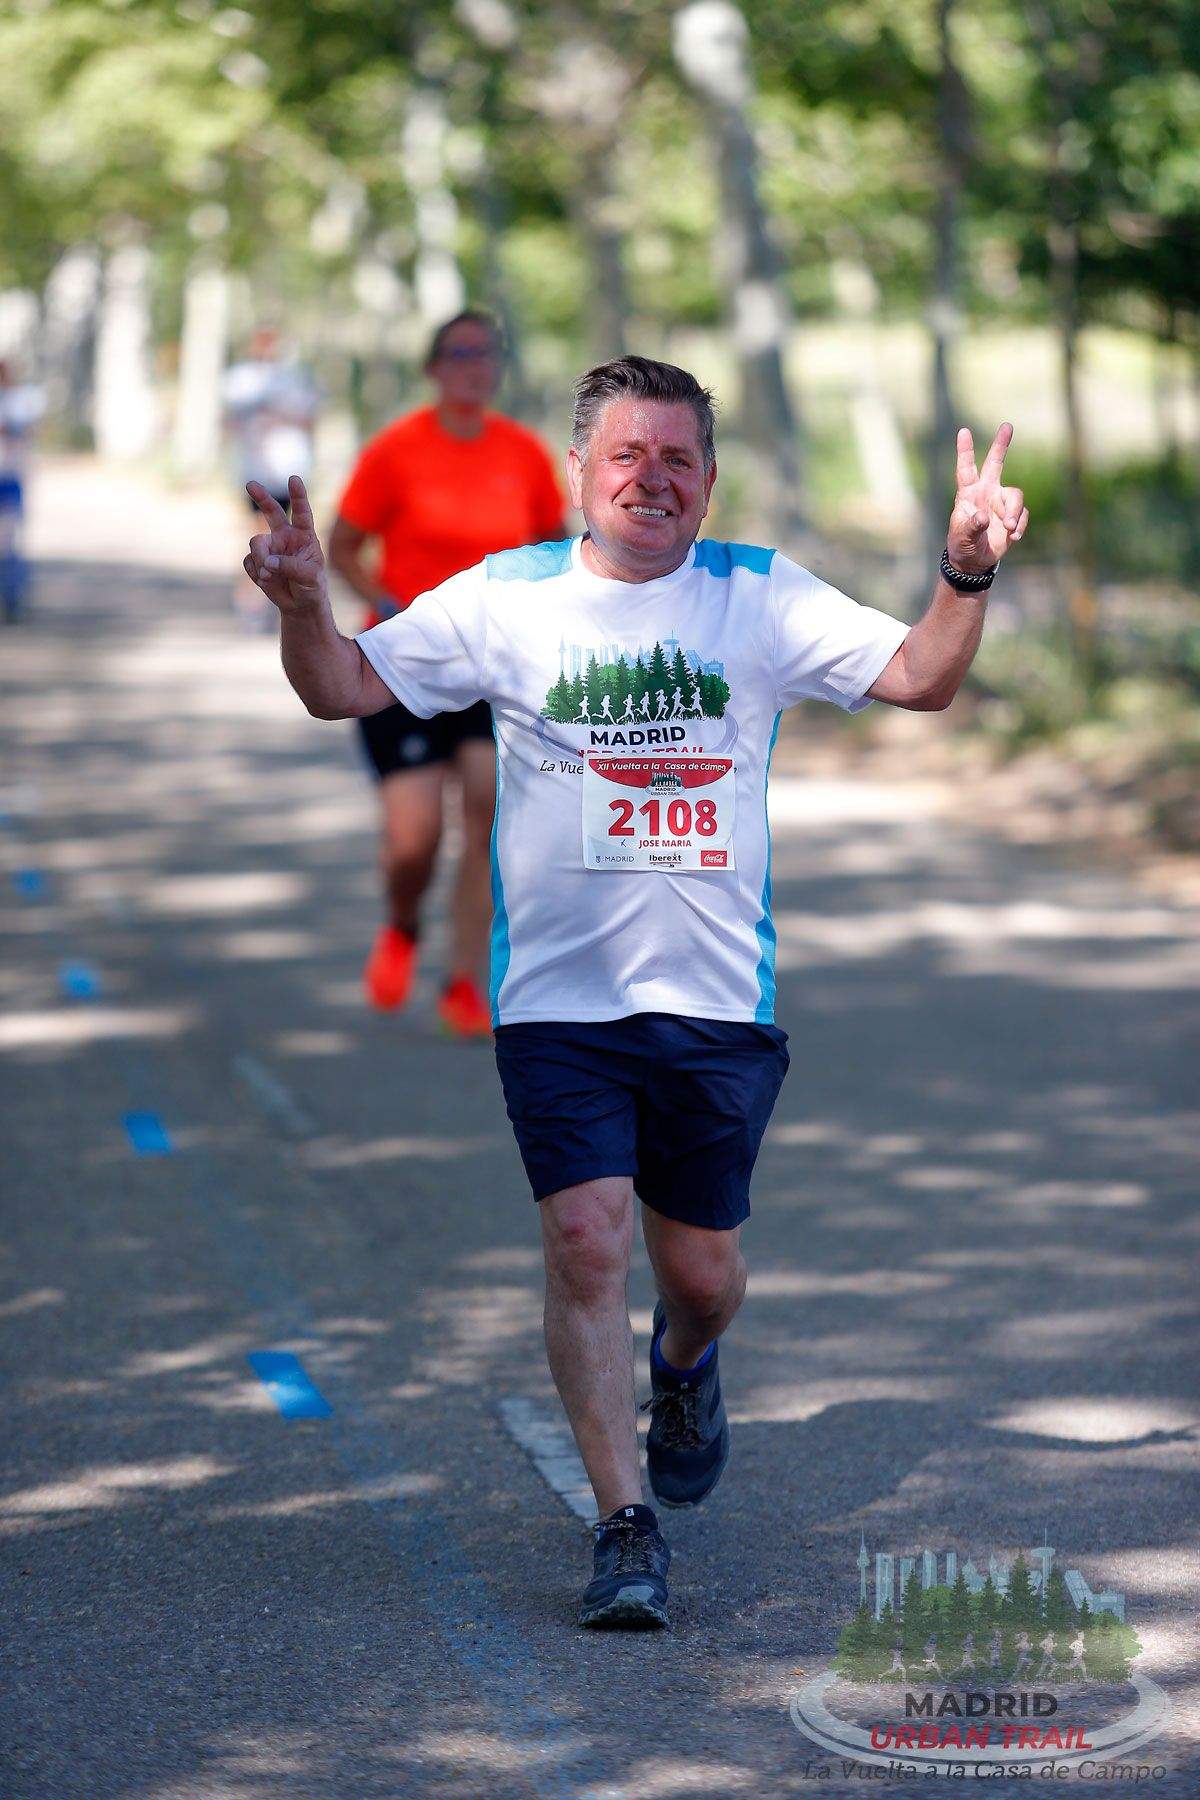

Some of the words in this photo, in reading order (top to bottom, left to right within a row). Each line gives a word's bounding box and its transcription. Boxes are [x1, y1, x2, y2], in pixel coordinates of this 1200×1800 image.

[590, 726, 686, 746] MADRID
[540, 760, 556, 772] La
[597, 763, 609, 771] XII
[611, 762, 641, 770] Vuelta
[651, 762, 660, 770] la
[664, 762, 686, 770] Casa
[688, 762, 699, 770] de
[700, 763, 726, 772] Campo
[608, 799, 718, 836] 2108
[639, 839, 660, 849] JOSE
[662, 839, 692, 847] MARIA
[604, 855, 635, 863] MADRID
[649, 854, 682, 862] Iberext
